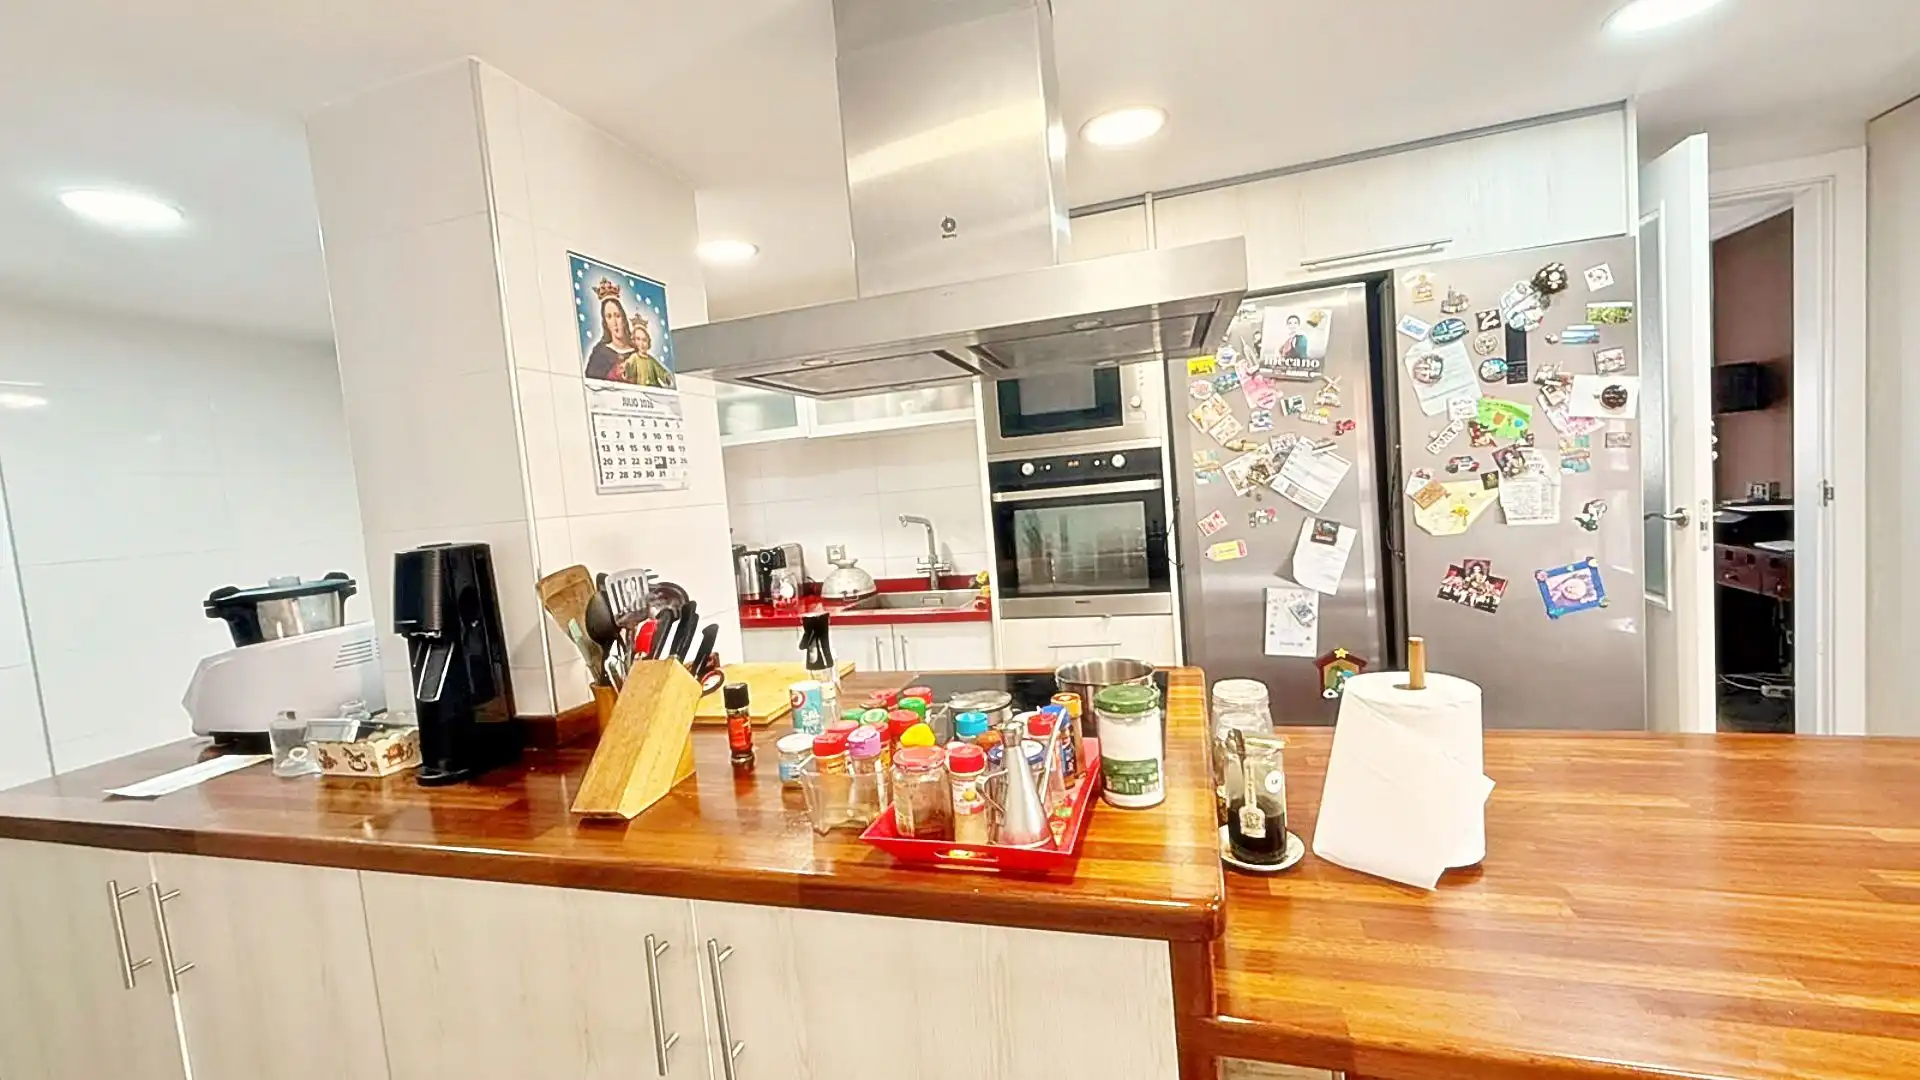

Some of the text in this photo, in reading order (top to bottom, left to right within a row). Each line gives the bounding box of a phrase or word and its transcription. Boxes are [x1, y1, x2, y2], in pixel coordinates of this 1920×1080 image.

[1264, 356, 1320, 368] mecano
[622, 396, 639, 407] JULIO
[605, 472, 614, 480] 27
